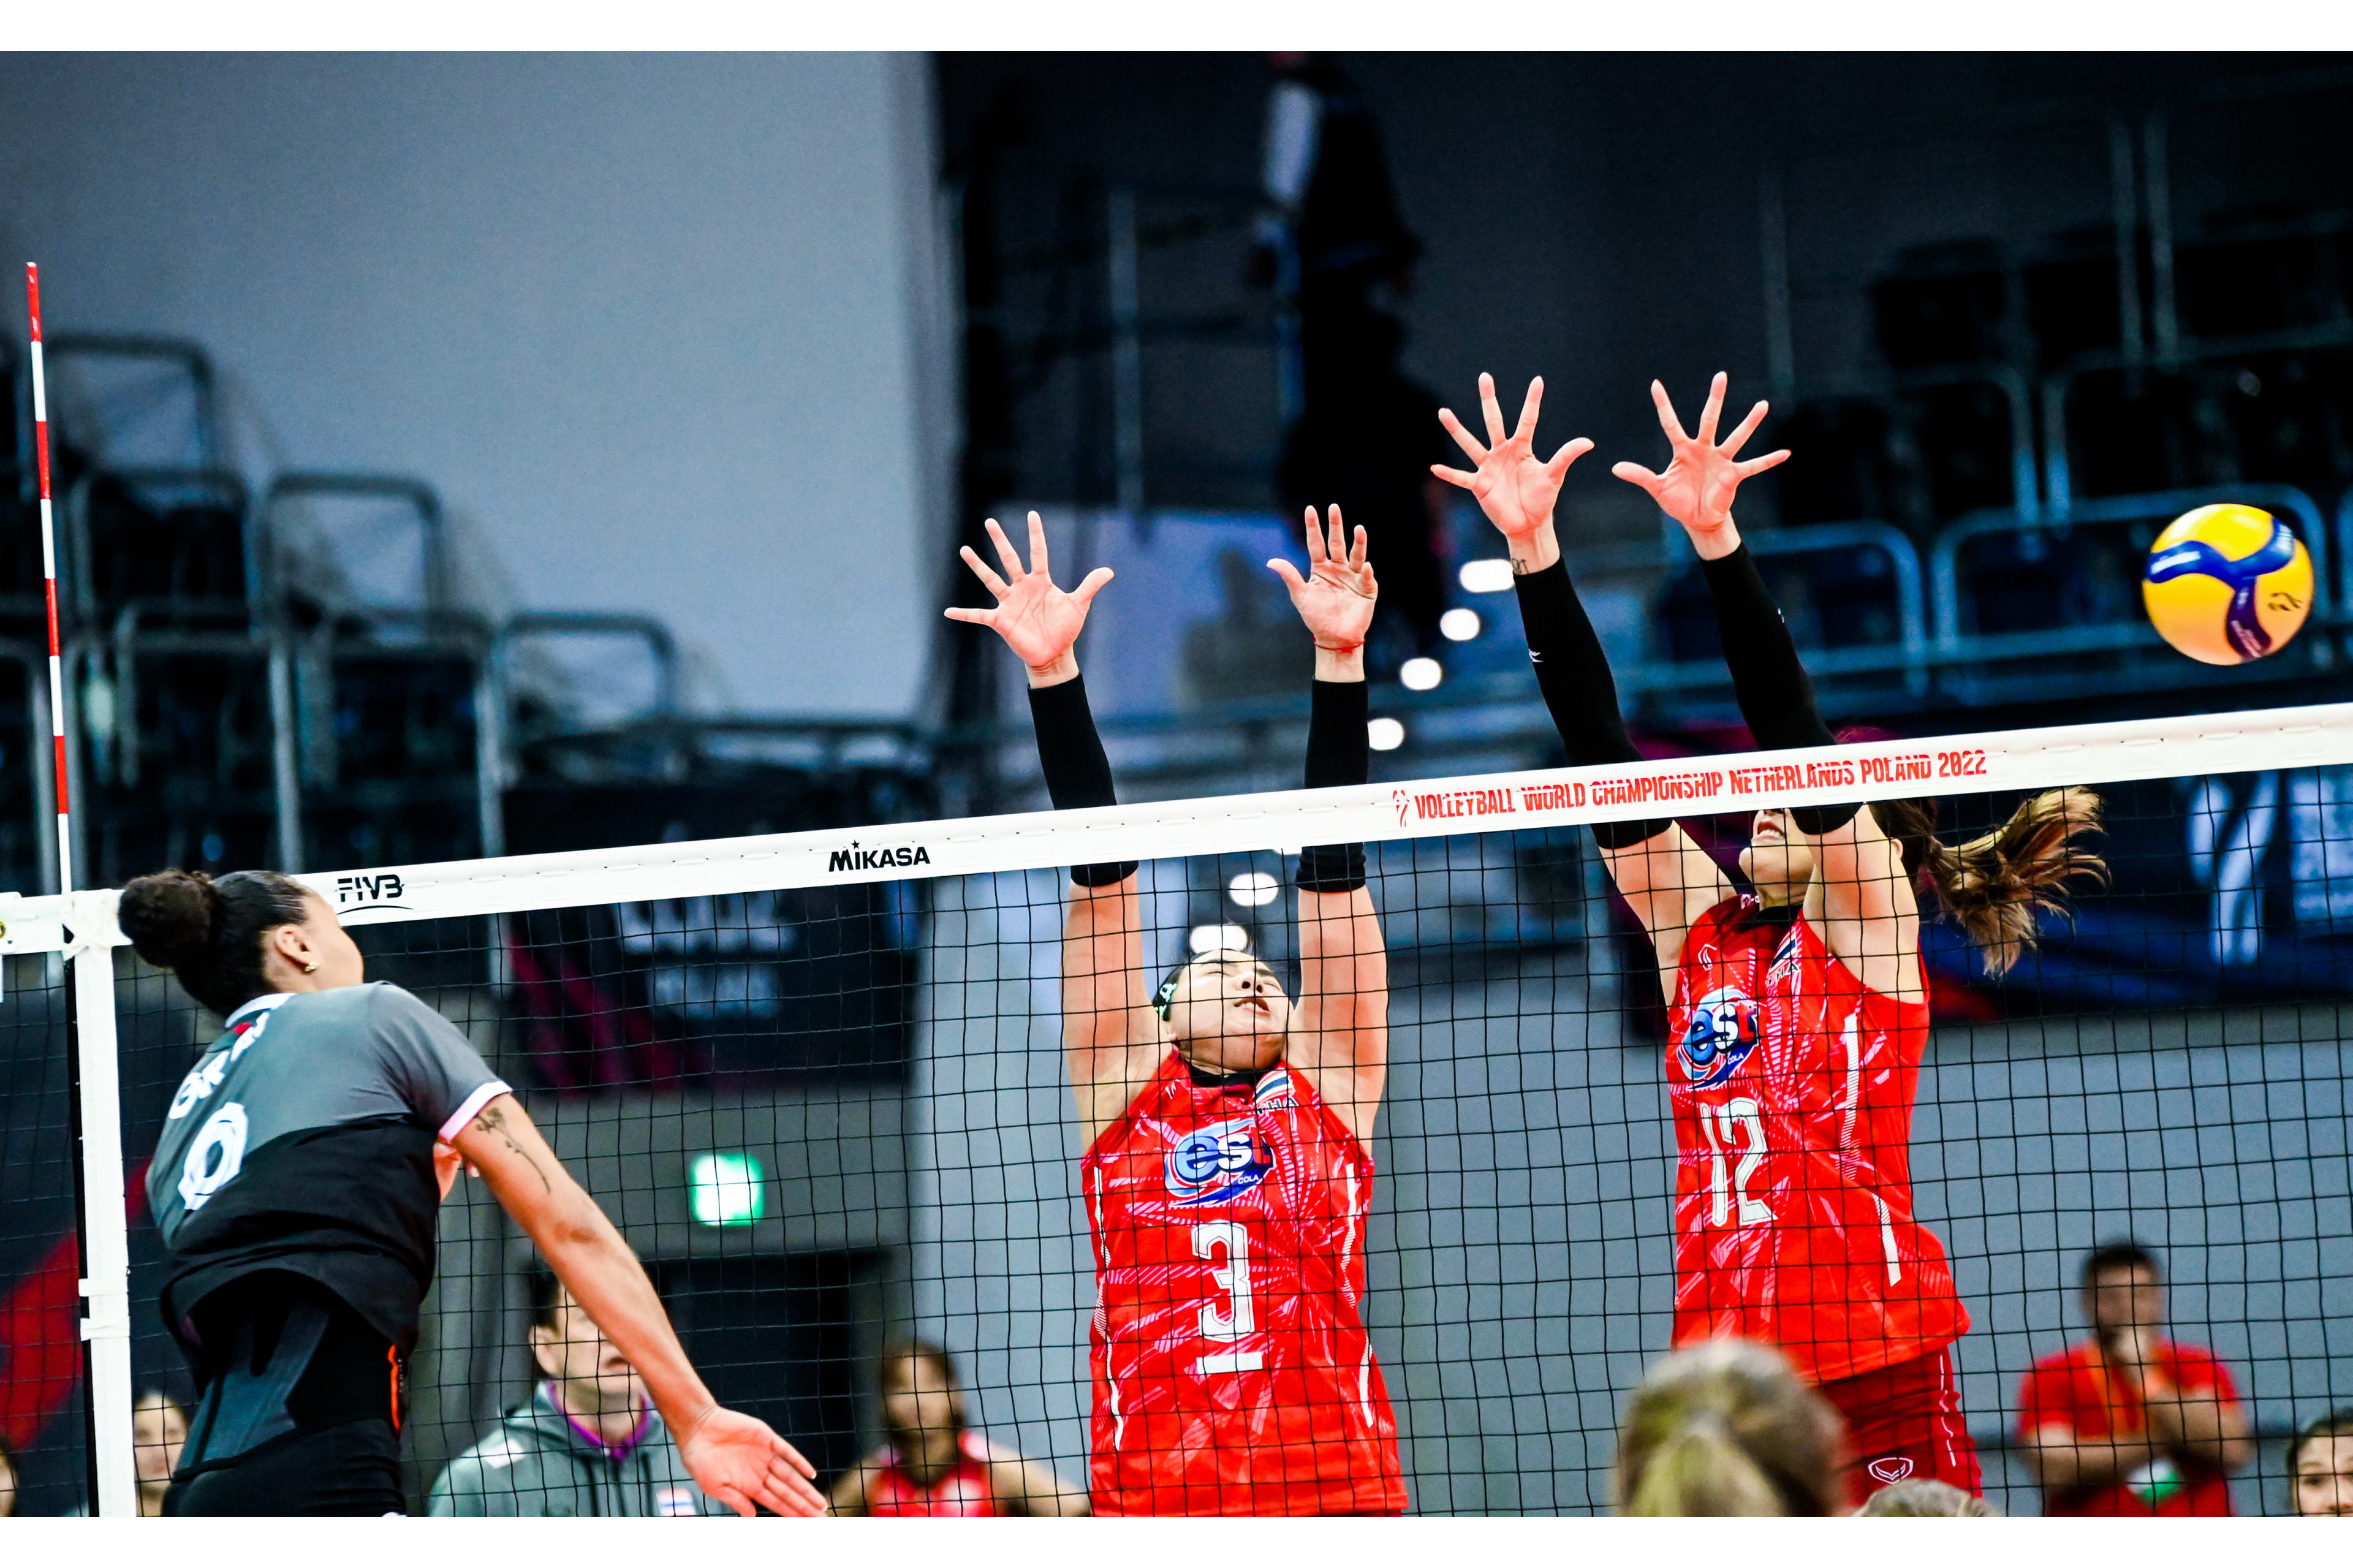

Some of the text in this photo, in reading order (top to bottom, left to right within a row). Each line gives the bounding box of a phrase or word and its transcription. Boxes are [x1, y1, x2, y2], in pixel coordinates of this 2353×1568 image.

[1414, 749, 1987, 819] VOLLEYBALL WORLD CHAMPIONSHIP NETHERLANDS POLAND 2022
[828, 846, 931, 873] MIKASA
[337, 874, 403, 903] FIVB
[1727, 1053, 1745, 1065] COLA
[1699, 1096, 1779, 1227] 12
[1237, 1173, 1260, 1185] COLA
[1191, 1219, 1256, 1343] 3
